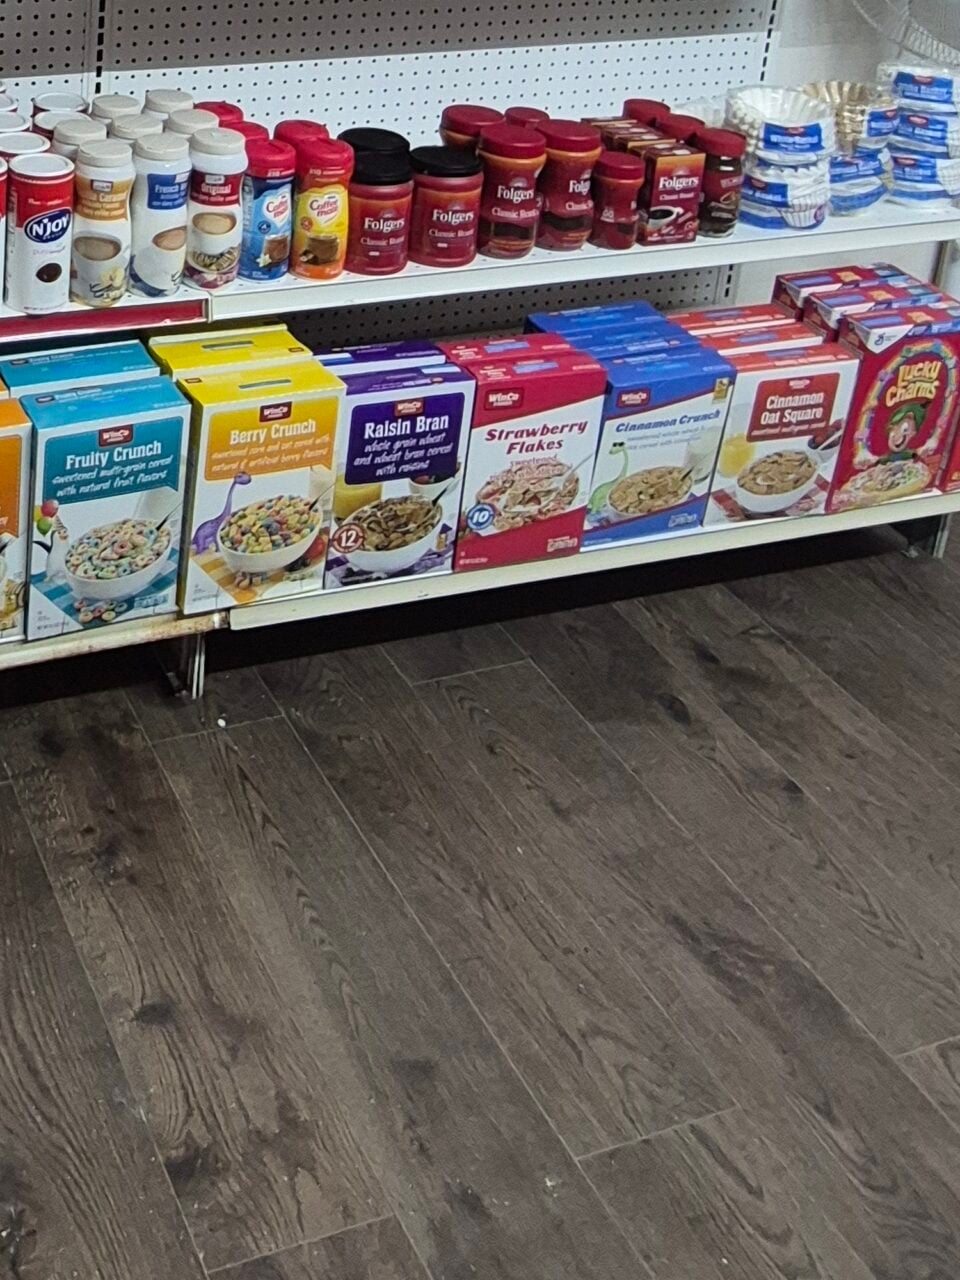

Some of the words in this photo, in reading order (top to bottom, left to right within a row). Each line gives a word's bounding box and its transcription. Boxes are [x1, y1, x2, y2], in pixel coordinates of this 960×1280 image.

[201, 183, 232, 196] Original
[659, 175, 699, 191] Folgers
[497, 185, 535, 204] Folgers
[309, 198, 338, 211] Coffee
[363, 217, 405, 234] Folgers
[432, 209, 475, 226] Folgers
[360, 236, 389, 246] Classic
[428, 229, 457, 240] Classic
[897, 361, 942, 384] Lucky
[766, 392, 825, 410] Cinnamon
[885, 379, 940, 407] Charms
[615, 417, 677, 433] Cinnamon
[678, 409, 722, 425] Crunch
[760, 411, 781, 426] Oat
[781, 406, 824, 424] Square
[230, 428, 268, 446] Berry
[271, 418, 317, 440] Crunch
[363, 418, 411, 440] Raisin
[415, 414, 450, 434] Bran
[484, 420, 589, 442] Strawberry
[364, 439, 390, 453] whole
[392, 437, 417, 454] grain
[419, 432, 447, 447] wheat
[506, 439, 564, 455] Flakes
[65, 450, 109, 471] Fruity
[113, 440, 162, 462] Crunch
[353, 454, 372, 467] and
[374, 450, 402, 464] wheat
[403, 446, 426, 460] bran
[426, 442, 454, 457] cereal
[375, 464, 396, 476] with
[473, 511, 489, 524] 10
[340, 528, 357, 548] 12
